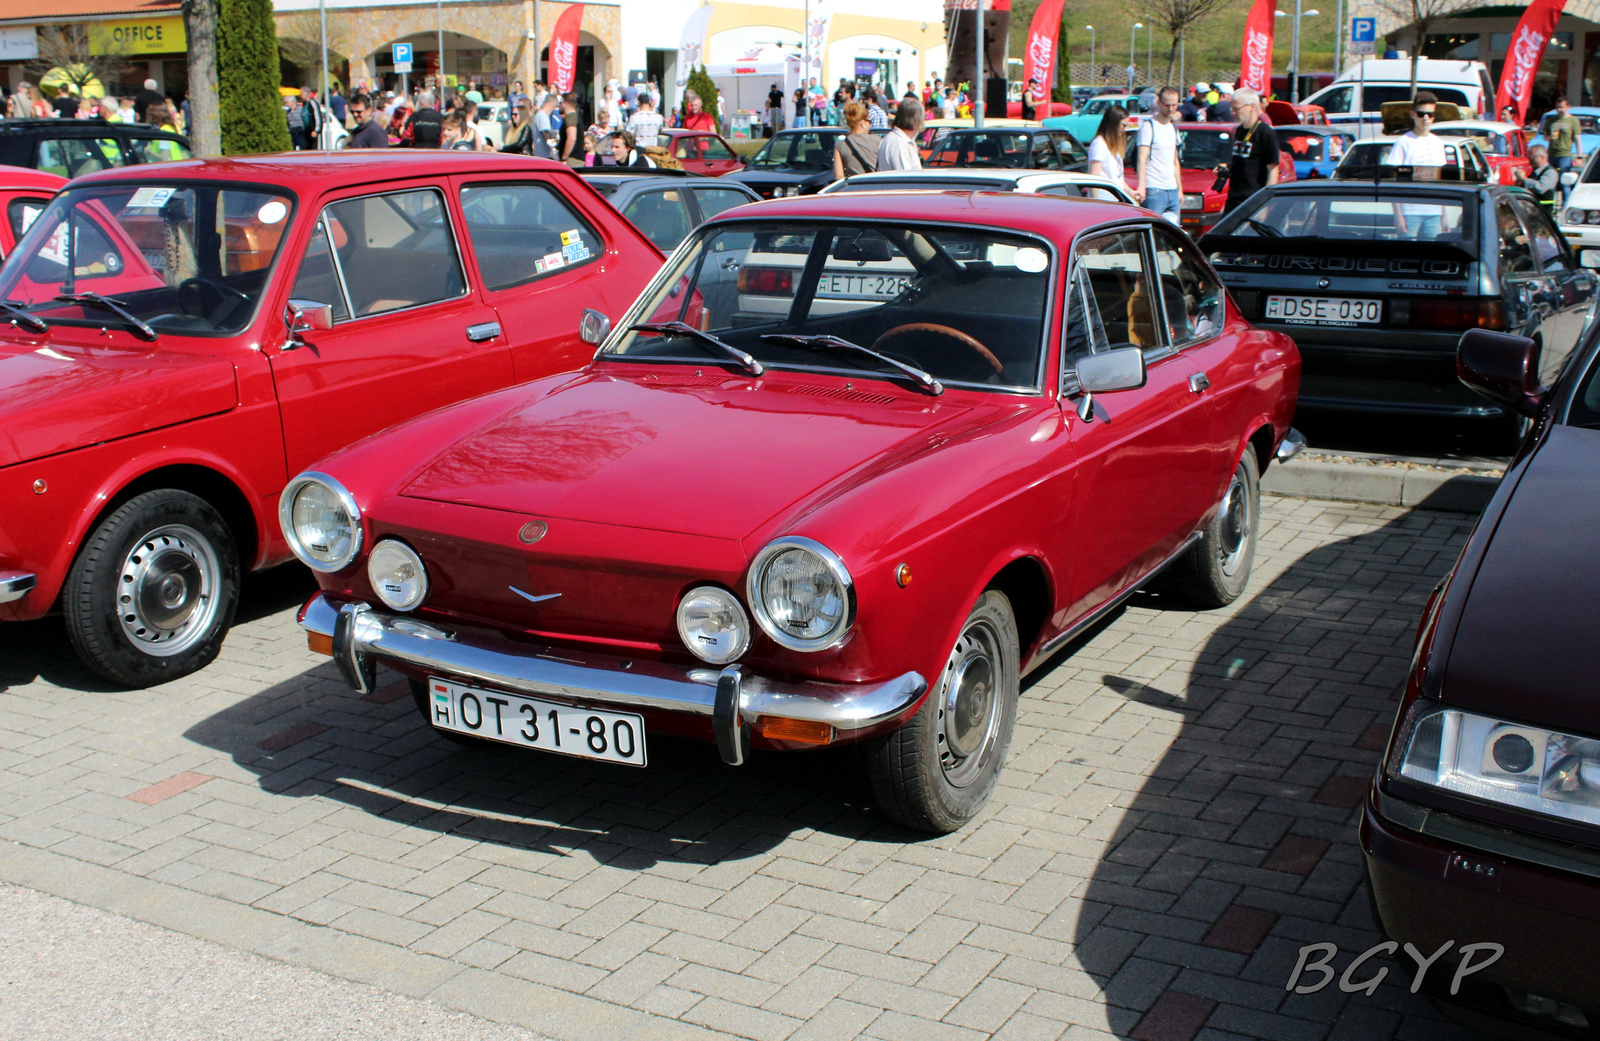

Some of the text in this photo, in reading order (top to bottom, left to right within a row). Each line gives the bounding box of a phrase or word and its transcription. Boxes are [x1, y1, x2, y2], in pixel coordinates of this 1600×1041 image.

[113, 25, 162, 41] OFFICE
[1355, 20, 1371, 39] P
[396, 46, 407, 60] P
[1209, 251, 1460, 274] SCIROCCO
[1269, 298, 1378, 320] H DSE-030
[1285, 318, 1317, 326] PORSCHE
[435, 704, 449, 724] H
